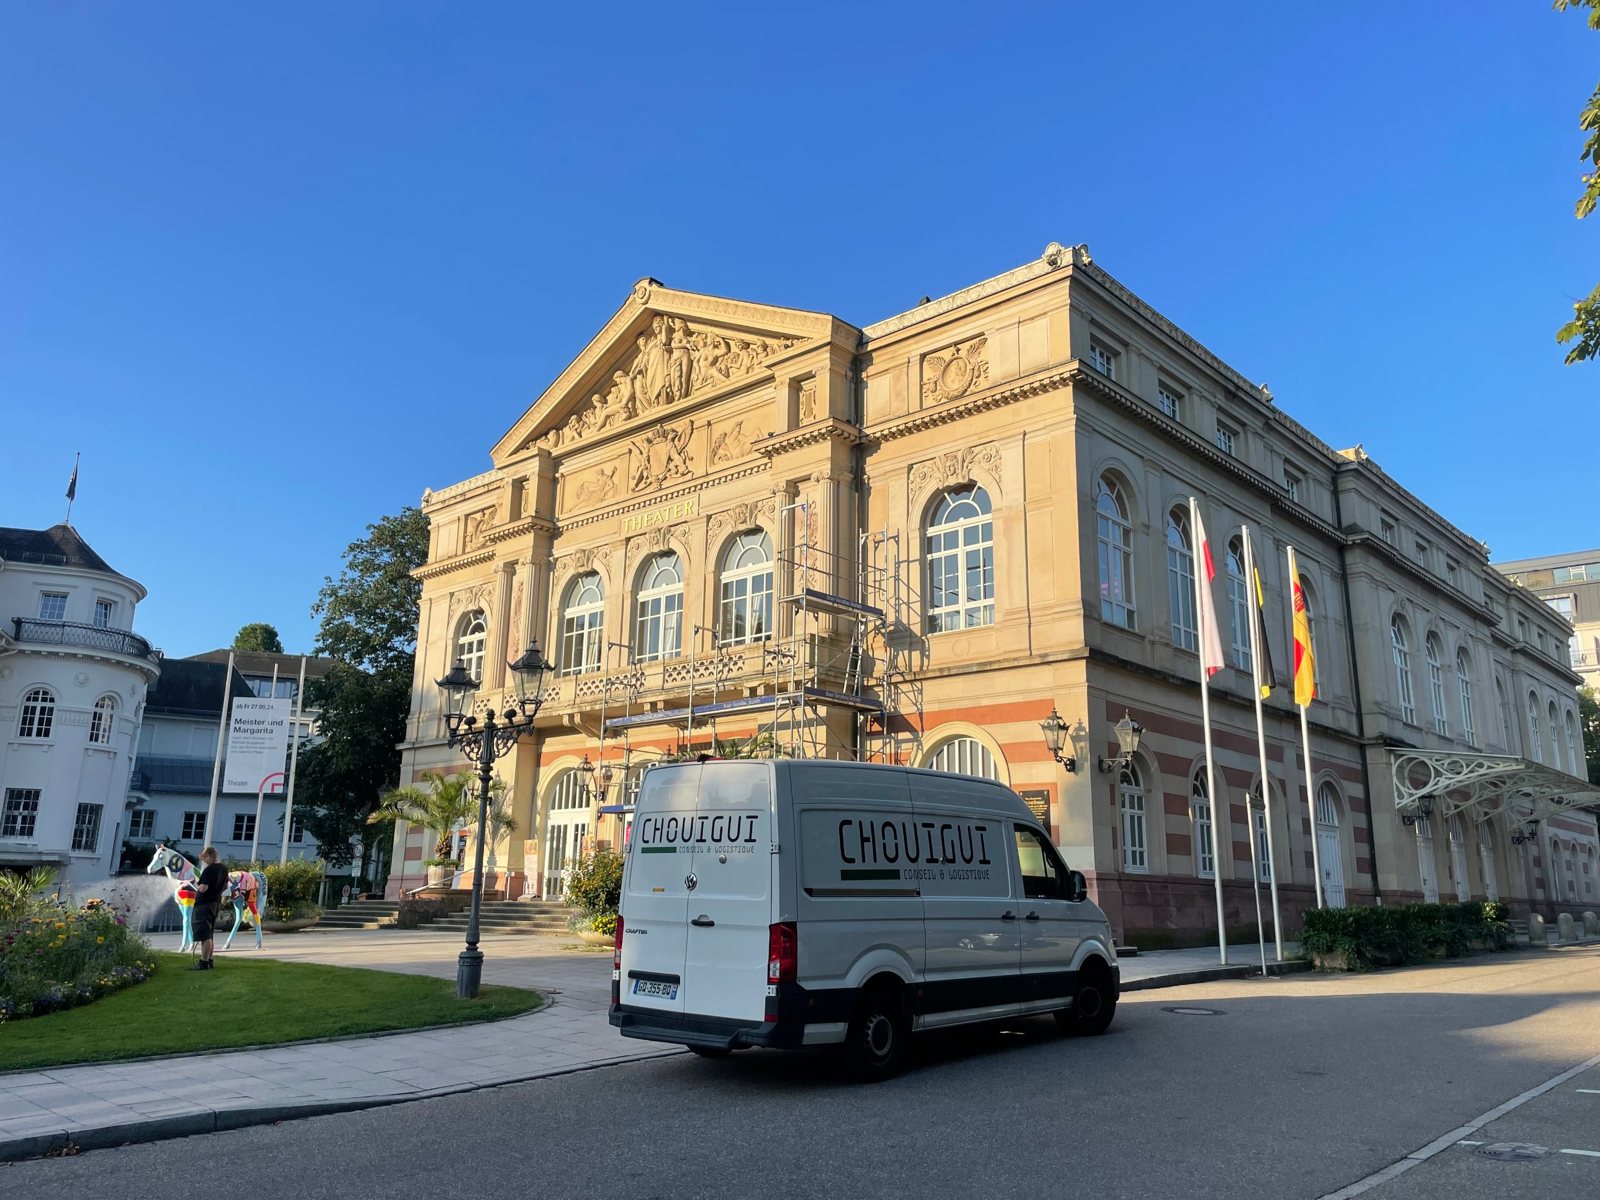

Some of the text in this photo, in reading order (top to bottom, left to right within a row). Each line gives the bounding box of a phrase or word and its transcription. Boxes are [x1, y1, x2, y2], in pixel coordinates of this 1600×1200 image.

[623, 499, 694, 533] THEATER
[234, 718, 265, 726] Meister
[233, 726, 274, 735] Margarita
[641, 815, 759, 844] CHOUIGUI
[838, 819, 991, 865] CHOUIGUI
[679, 845, 704, 854] CONSEIL
[714, 845, 755, 854] LOGISTIQUE
[903, 868, 937, 880] CONSEIL
[948, 869, 991, 880] LOGISTIQUE
